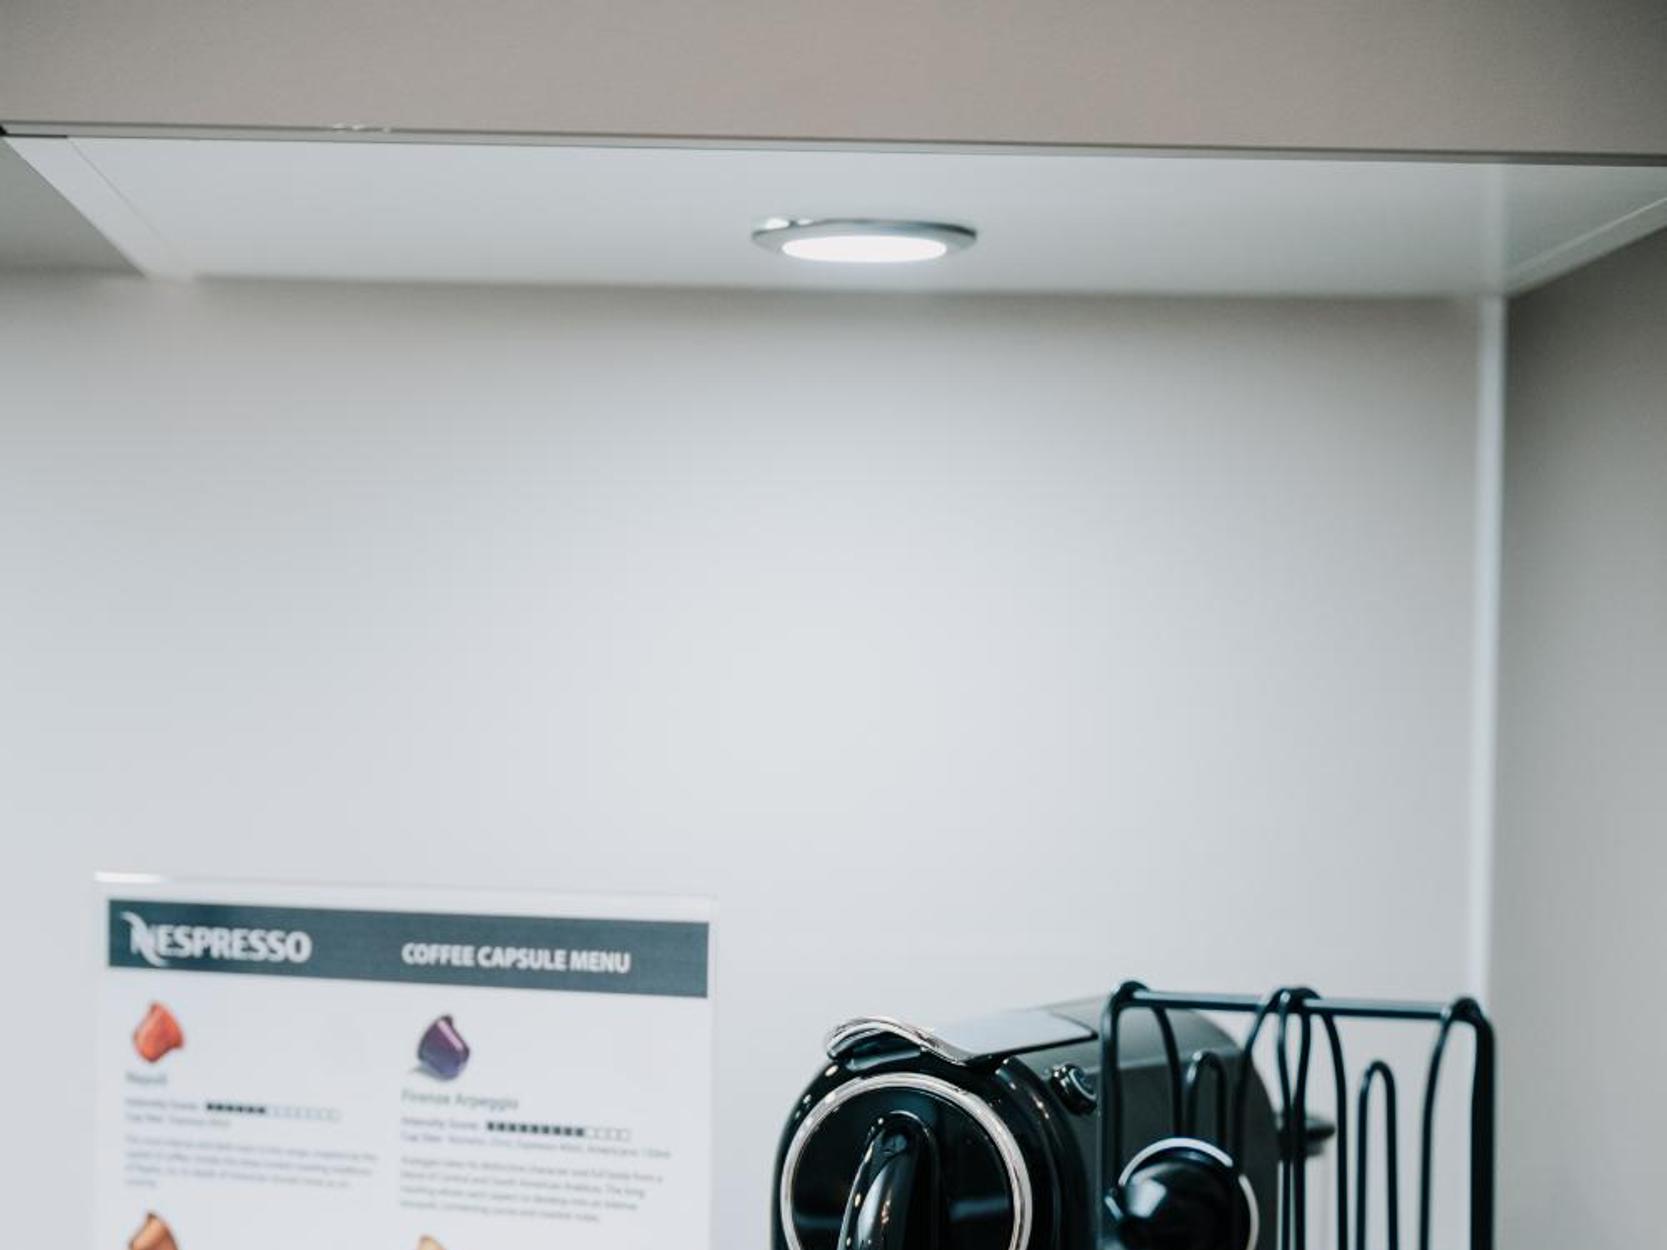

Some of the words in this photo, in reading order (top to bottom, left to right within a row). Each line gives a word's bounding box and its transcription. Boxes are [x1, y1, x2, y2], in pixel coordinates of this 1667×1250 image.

[119, 911, 312, 967] NESPRESSO
[401, 942, 475, 967] COFFEE
[477, 946, 567, 971] CAPSULE
[570, 950, 631, 974] MENU
